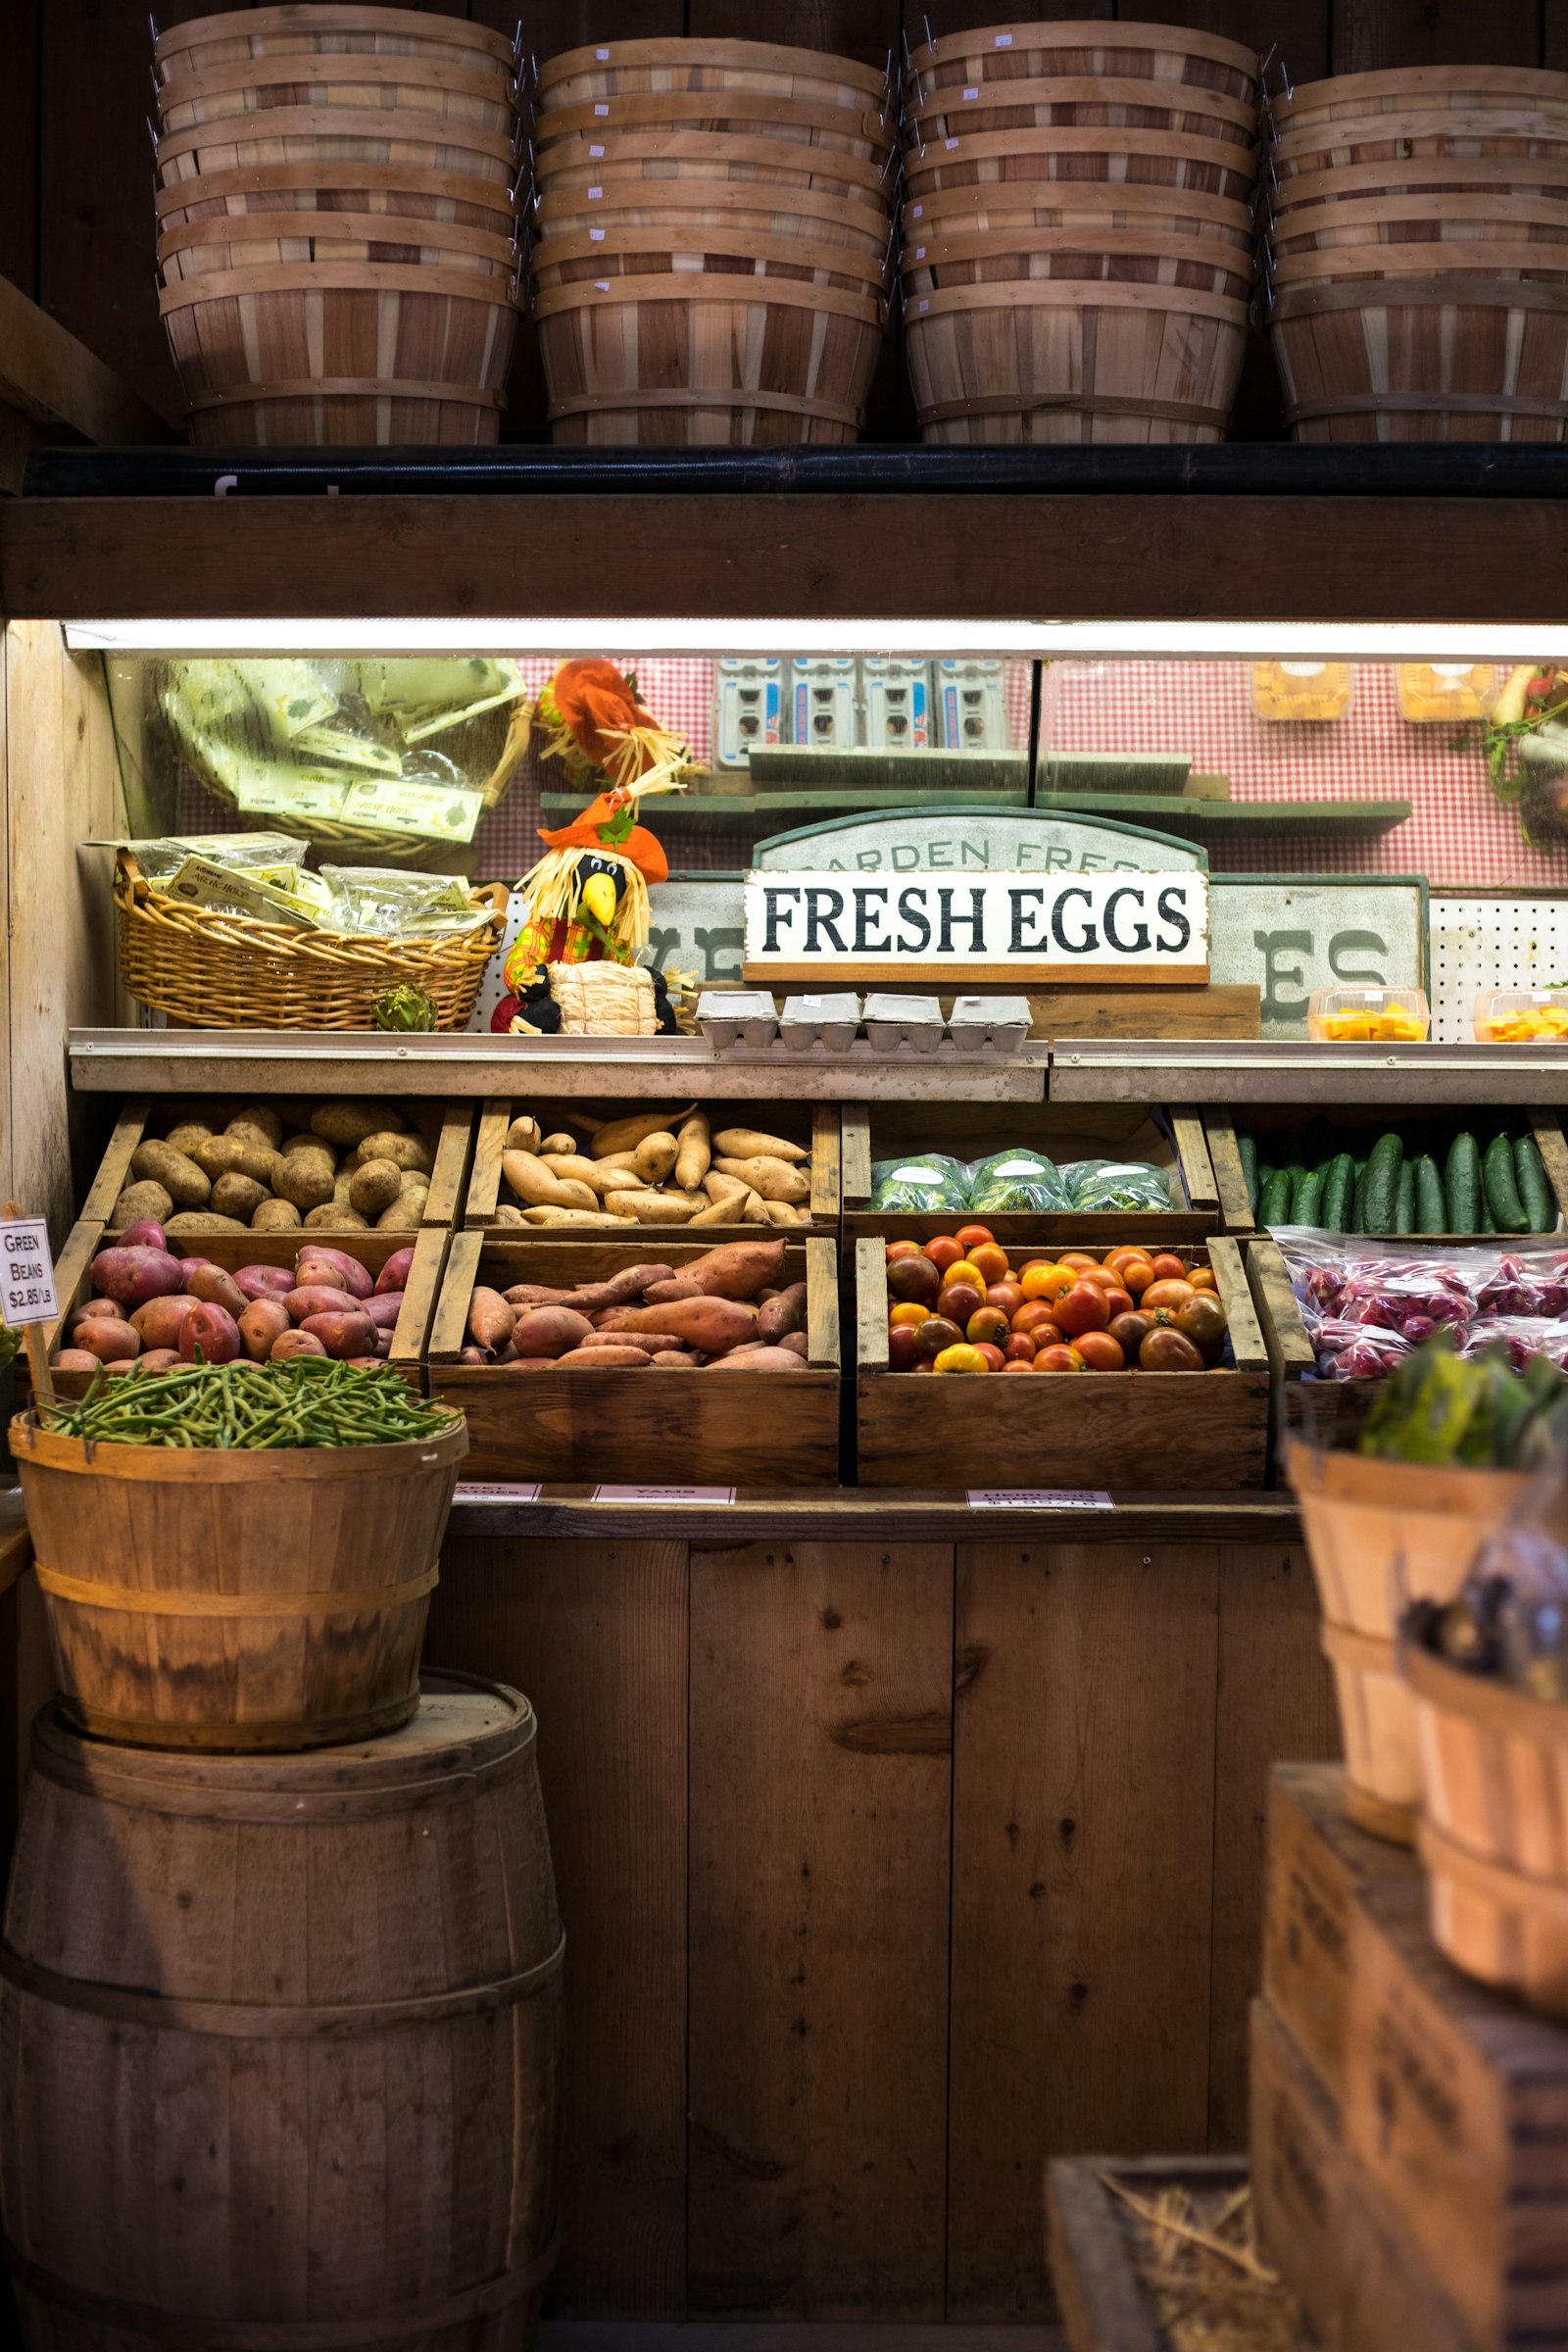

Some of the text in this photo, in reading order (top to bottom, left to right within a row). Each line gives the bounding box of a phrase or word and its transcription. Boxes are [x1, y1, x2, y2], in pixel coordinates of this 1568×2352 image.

[800, 840, 1140, 871] RDEN FRE
[761, 887, 1192, 954] FRESH EGGS
[4, 1234, 39, 1253] GREEN
[10, 1262, 43, 1282] BEANS
